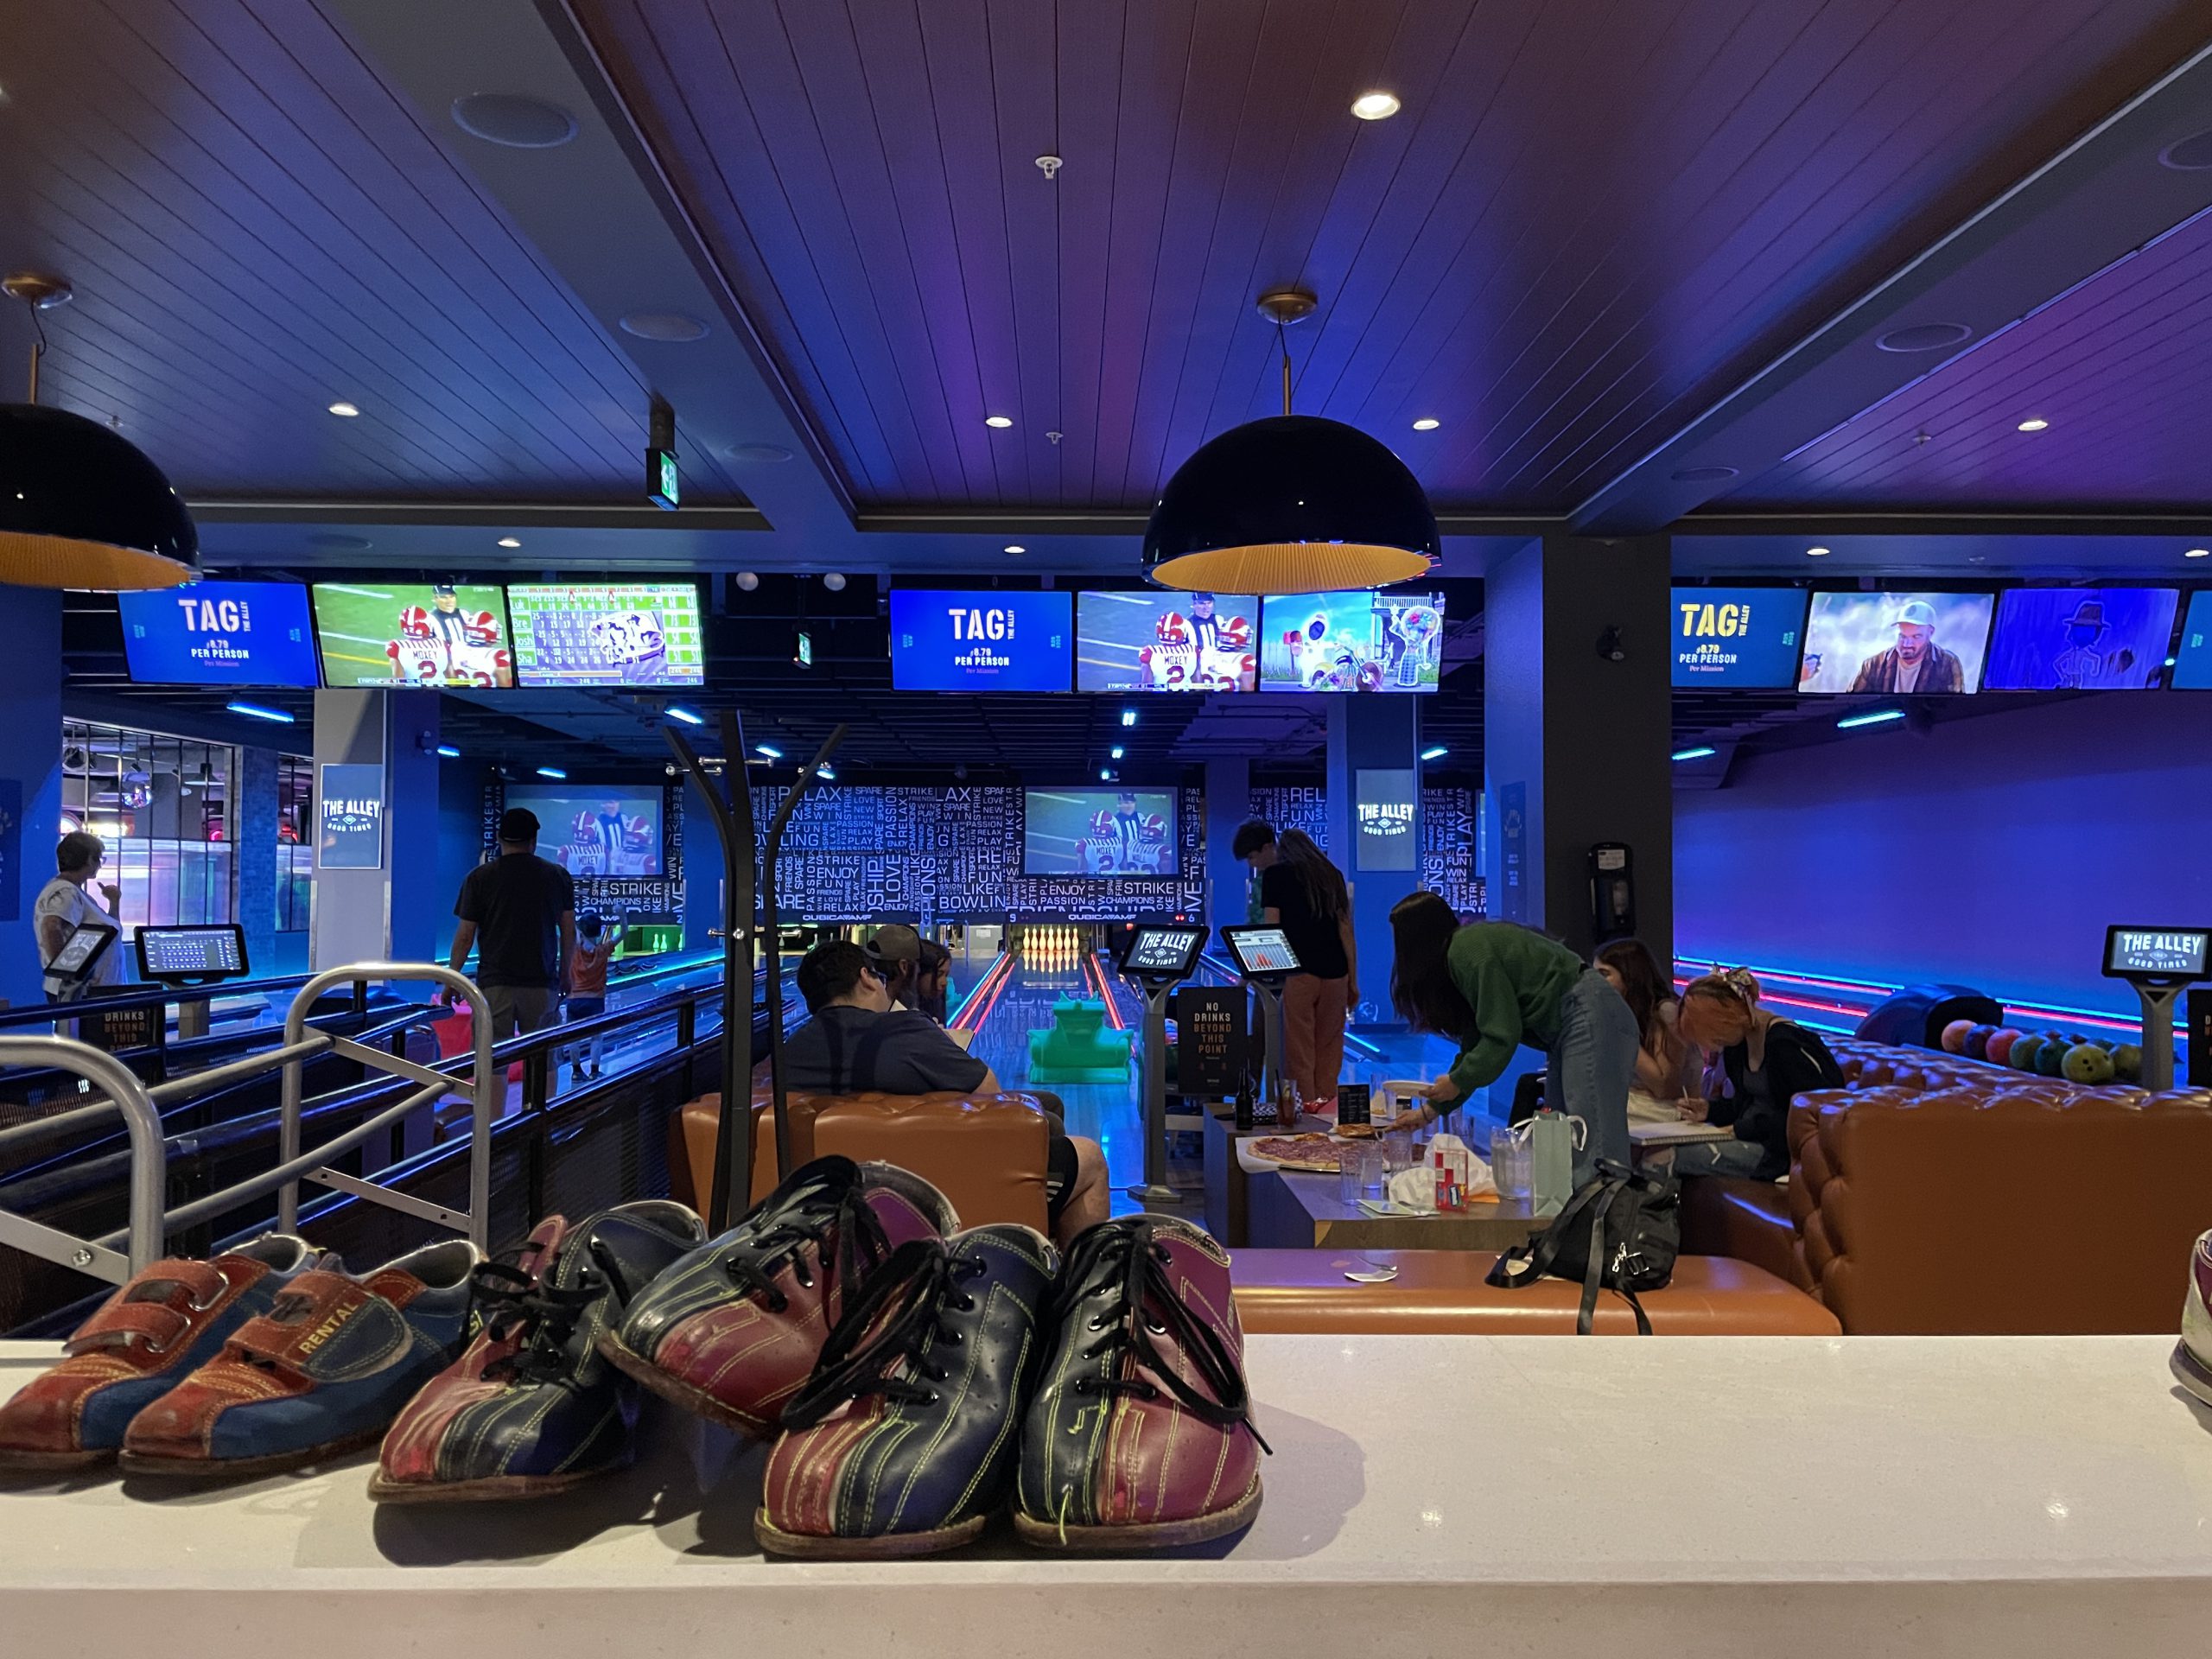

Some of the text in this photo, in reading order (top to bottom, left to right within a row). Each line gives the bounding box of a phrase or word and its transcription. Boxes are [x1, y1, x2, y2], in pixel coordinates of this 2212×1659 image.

[178, 600, 240, 632] TAG
[512, 616, 527, 628] Bre
[1681, 604, 1739, 637] TAG
[949, 608, 1005, 640] TAG
[191, 648, 250, 659] PER PERSON
[413, 651, 437, 660] MOXEY
[1679, 653, 1738, 664] PER PERSON
[955, 657, 1010, 666] PER PERSON
[1164, 655, 1187, 665] MOXEY
[417, 660, 437, 678] 2
[1166, 665, 1185, 683] 2
[855, 786, 882, 795] SPARE
[1291, 787, 1325, 802] REL
[322, 800, 380, 818] THE ALLEY
[813, 802, 841, 811] SPARE
[843, 786, 852, 821] STRIKE
[813, 811, 842, 820] WIN
[885, 787, 897, 838] PASSION
[899, 798, 907, 837] RELAX
[1281, 810, 1314, 822] FUN
[1357, 804, 1414, 822] THE ALLEY
[1457, 810, 1472, 857] PLAY
[1096, 847, 1116, 855] MOXEY
[816, 855, 860, 865] STRIKE
[910, 849, 920, 875] LIKE
[1446, 856, 1467, 866] FUN
[795, 857, 804, 889] SPARE
[817, 868, 859, 879] ENJOY
[969, 871, 1001, 883] FUN
[1446, 868, 1467, 877] WIN
[806, 856, 815, 912] PASSION
[817, 880, 843, 888] FUN
[886, 855, 900, 903] LOVE
[610, 882, 662, 895] STRIKE
[963, 883, 994, 895] LIKE
[1050, 885, 1085, 895] ENJOY
[1124, 882, 1174, 894] STRIKE
[939, 895, 1006, 909] BOWLIN
[1106, 896, 1155, 905] CHAMPIONS
[823, 903, 859, 912] RELAX
[677, 915, 683, 924] 2
[1188, 913, 1195, 923] 6
[1140, 932, 1195, 952] THE ALLEY
[2123, 934, 2201, 955] THE ALLEY
[1206, 1002, 1218, 1011] NO
[105, 1011, 144, 1021] DRINKS
[1194, 1013, 1230, 1022] DRINKS
[1193, 1024, 1231, 1033] BEYOND
[1202, 1034, 1224, 1043] THIS
[1198, 1044, 1228, 1054] POINT
[299, 1302, 359, 1354] RENTAL
